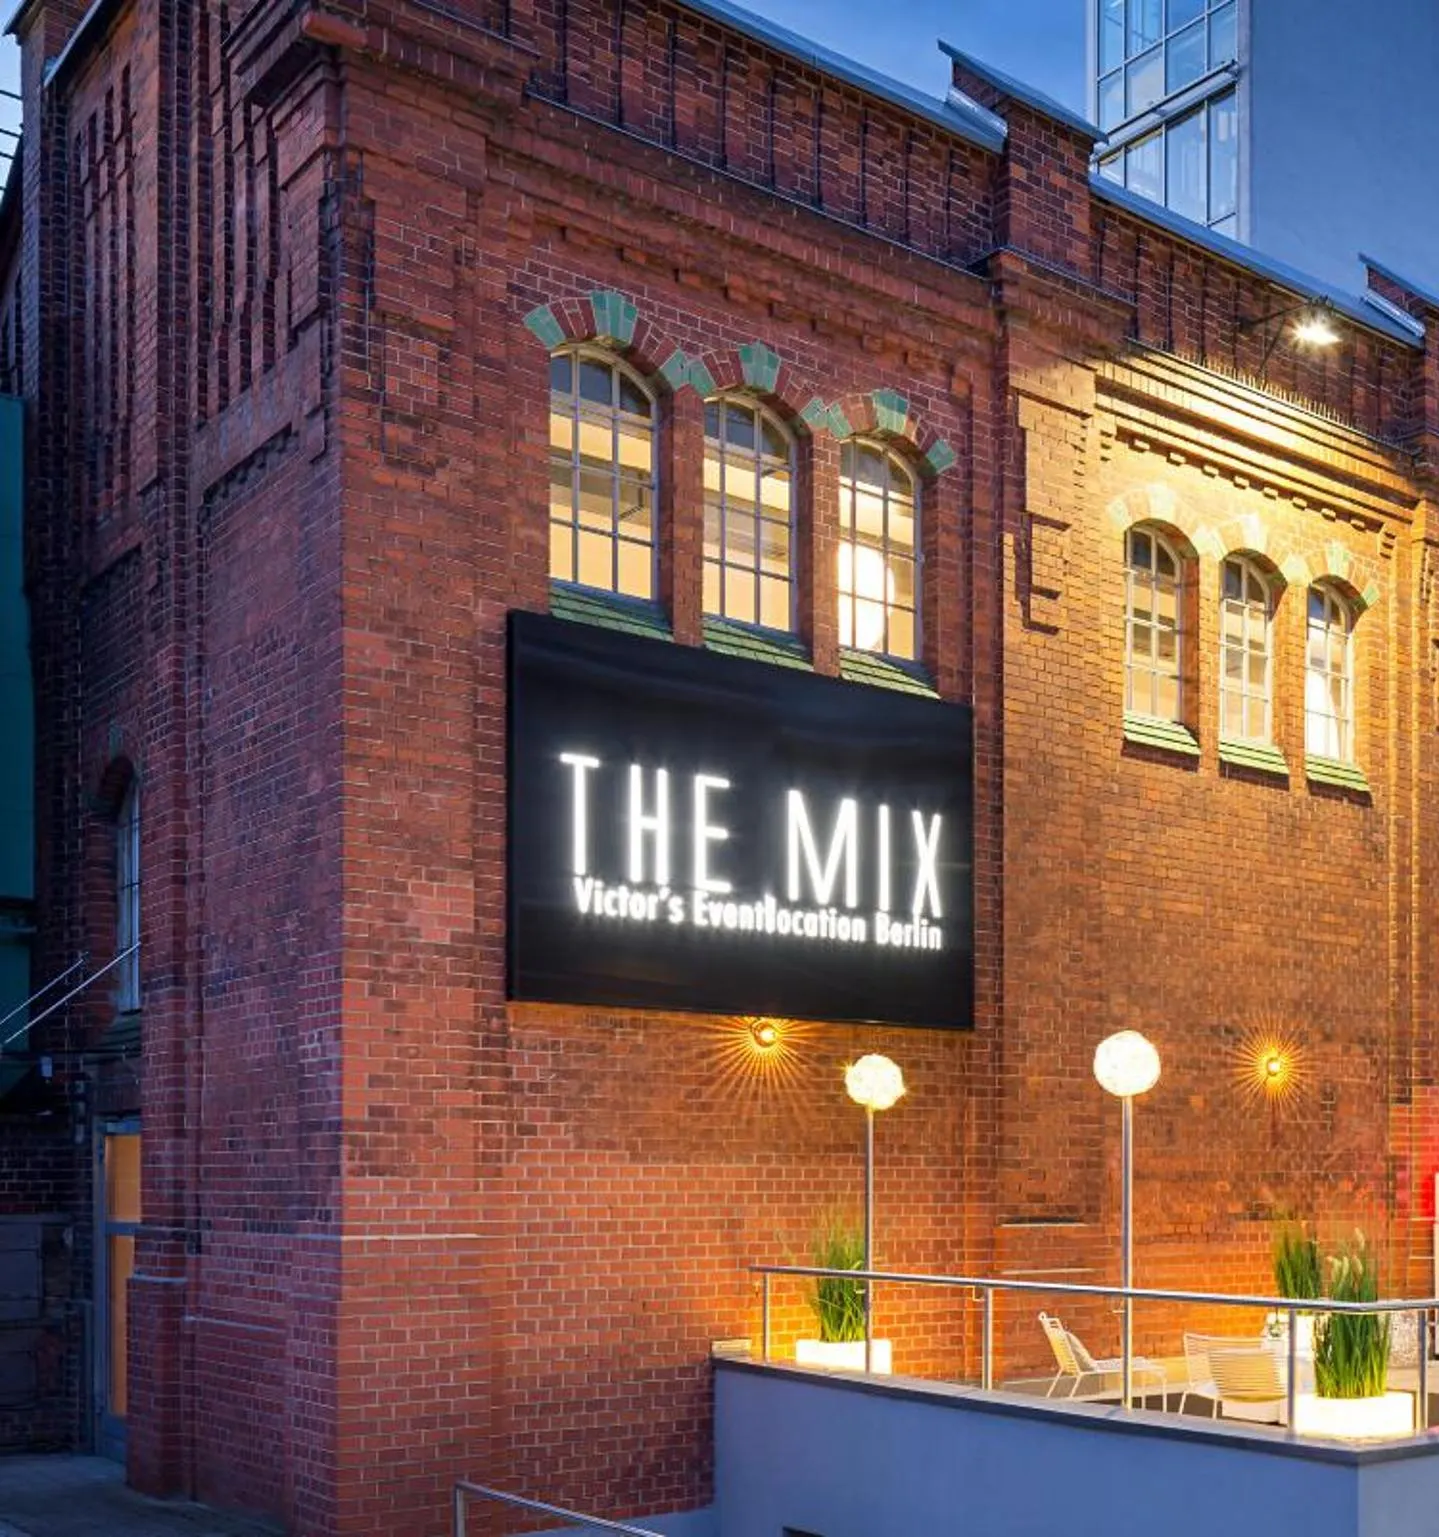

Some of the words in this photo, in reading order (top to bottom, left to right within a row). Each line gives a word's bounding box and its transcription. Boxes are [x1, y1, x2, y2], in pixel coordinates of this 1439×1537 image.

[559, 751, 731, 894] THE
[787, 788, 943, 919] MIX
[573, 875, 685, 925] Victor's
[693, 889, 867, 943] Eventlocation
[875, 909, 942, 950] Berlin
